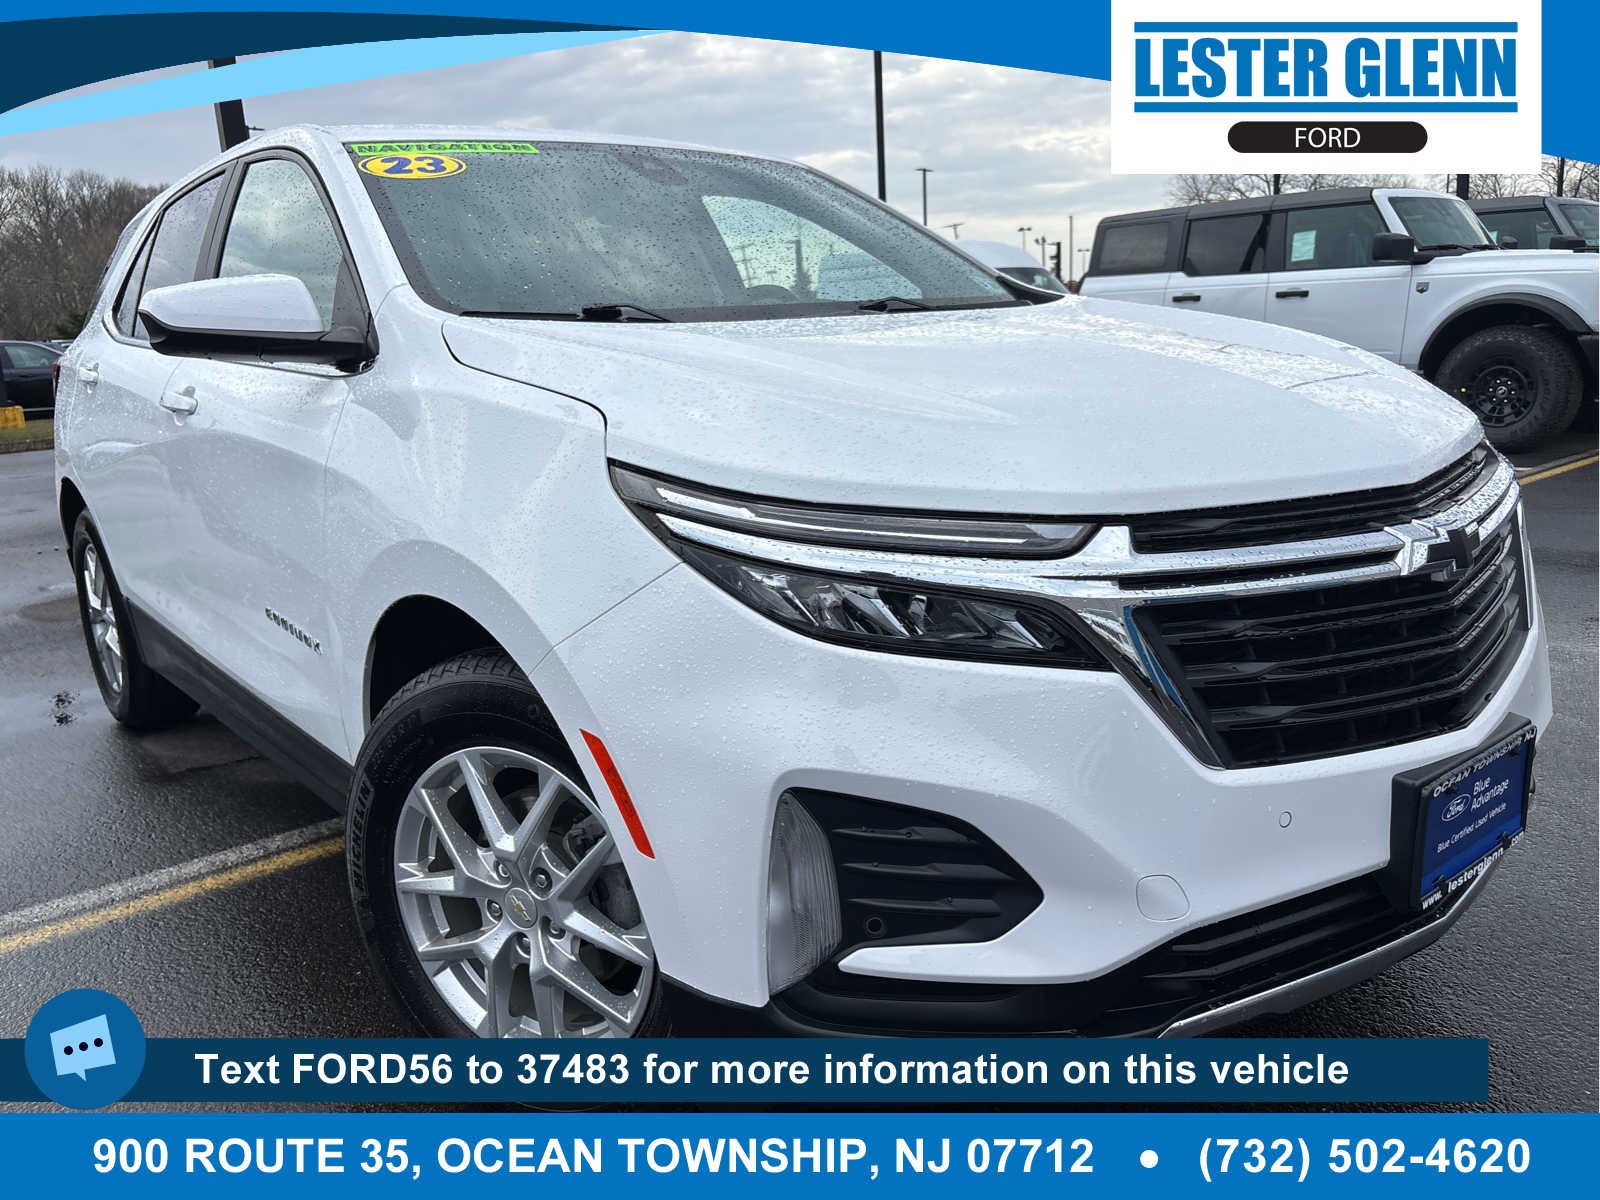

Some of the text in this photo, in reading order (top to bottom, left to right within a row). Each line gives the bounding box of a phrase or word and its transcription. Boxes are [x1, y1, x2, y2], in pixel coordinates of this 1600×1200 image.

[357, 144, 531, 154] NAVIGATION
[380, 156, 447, 175] 23
[1433, 727, 1537, 797] OCEAN TOWNSHIP NJ
[1471, 779, 1510, 812] Advantage
[1473, 777, 1491, 795] Blue
[1445, 797, 1467, 819] Ford
[351, 781, 371, 888] MICHELIN
[1437, 802, 1507, 854] Blue Certified Used Vehicle
[1422, 890, 1443, 910] www.
[1448, 847, 1504, 893] lesterglenn
